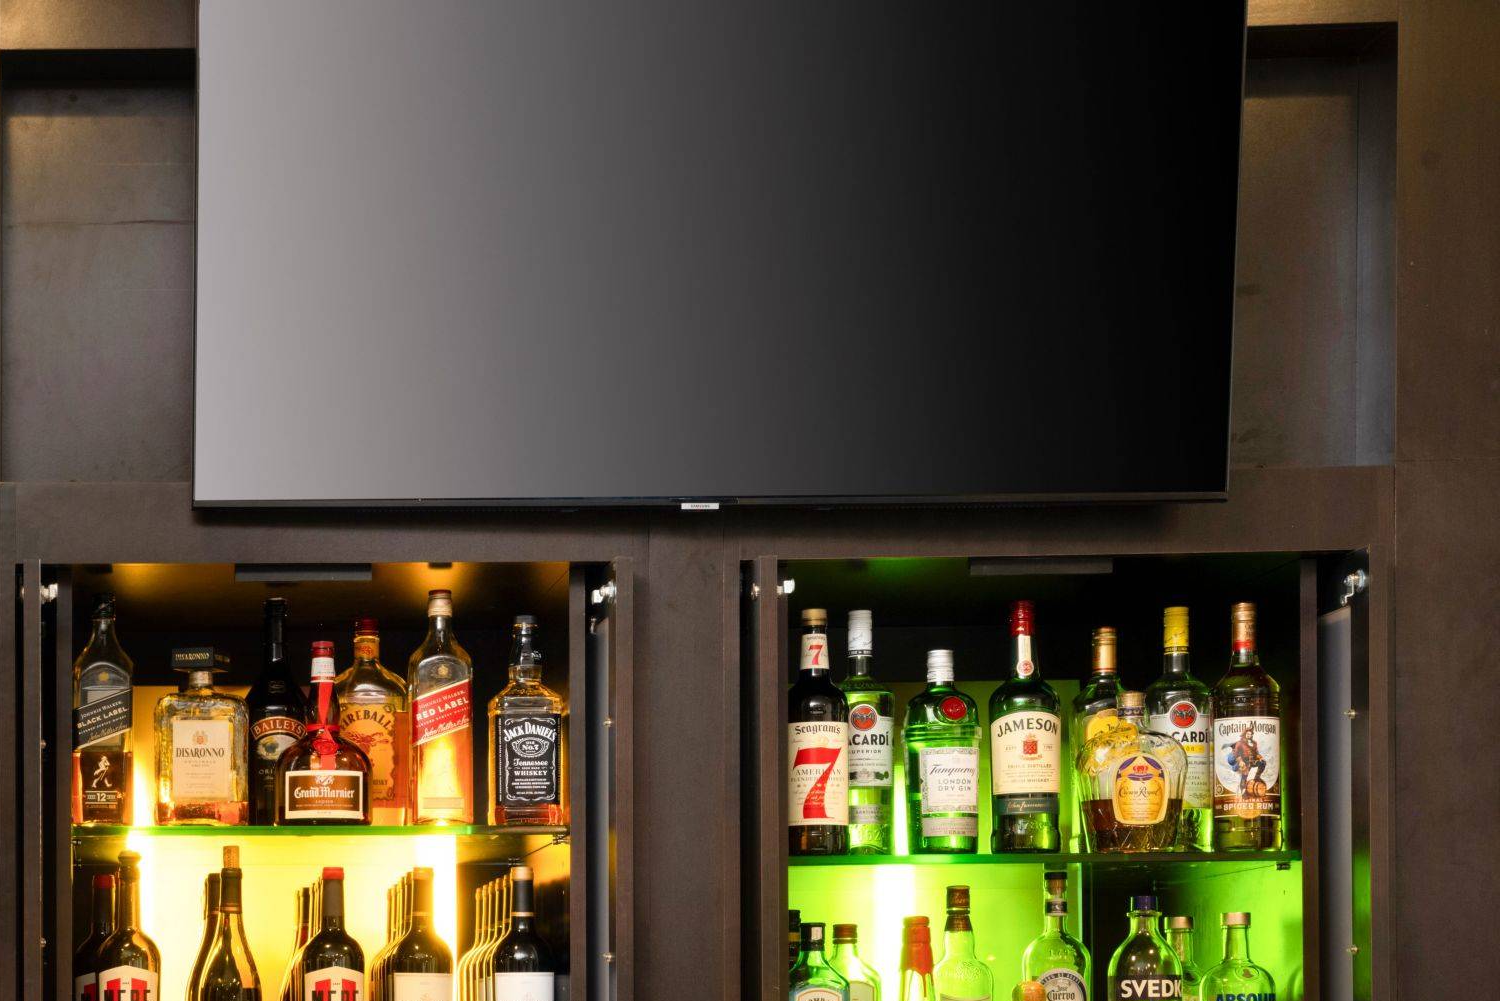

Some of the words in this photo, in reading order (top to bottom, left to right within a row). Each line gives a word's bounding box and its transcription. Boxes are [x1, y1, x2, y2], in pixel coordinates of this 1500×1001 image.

[175, 652, 210, 660] DISARONNO
[808, 644, 824, 666] 7
[416, 708, 436, 721] RED
[437, 696, 470, 713] LABEL
[77, 715, 102, 729] BLACK
[103, 706, 128, 719] LABEL
[253, 719, 303, 735] BAILEYS
[503, 723, 524, 743] JACK
[524, 721, 558, 743] DANIEL'S
[794, 725, 841, 736] Seagram's
[997, 717, 1058, 738] JAMESON
[1218, 721, 1247, 737] Captain
[1249, 720, 1277, 736] Morgan
[176, 747, 225, 759] DISARONNO
[513, 758, 549, 767] Tennessee
[792, 746, 842, 819] 7
[96, 793, 107, 802] 12
[294, 783, 319, 799] Grand
[320, 785, 355, 799] Marnier
[1223, 803, 1254, 811] SPICED
